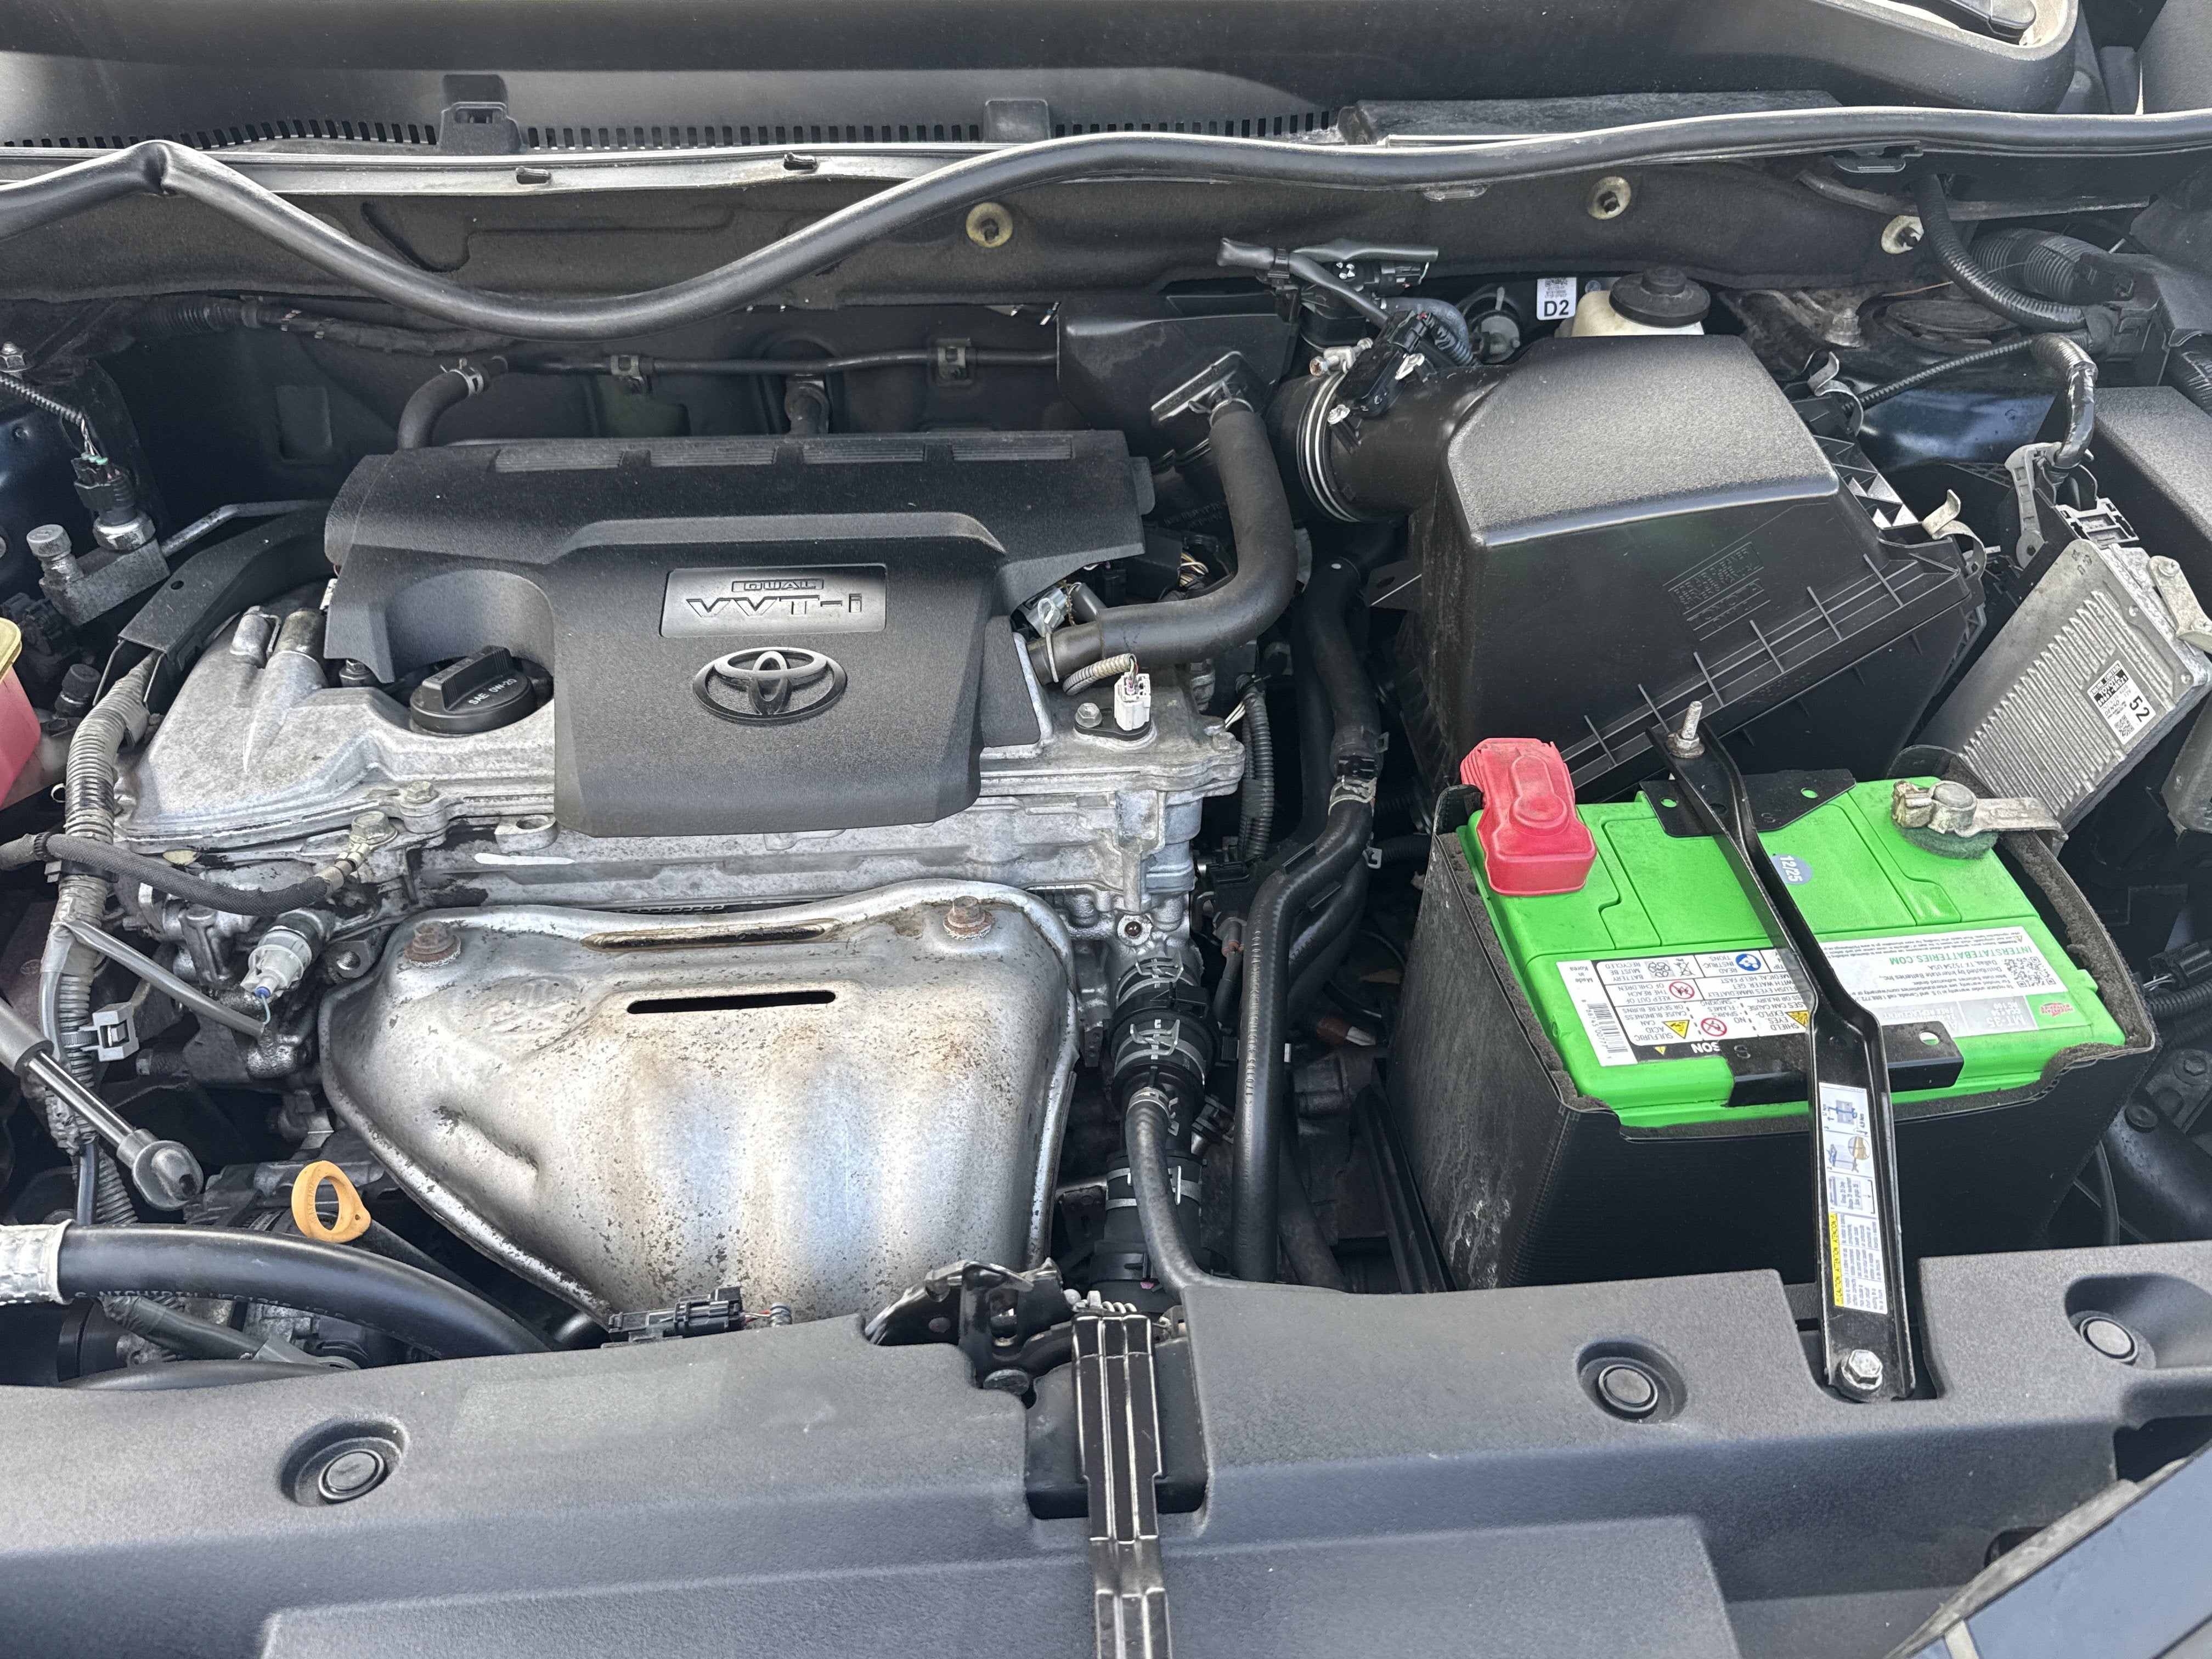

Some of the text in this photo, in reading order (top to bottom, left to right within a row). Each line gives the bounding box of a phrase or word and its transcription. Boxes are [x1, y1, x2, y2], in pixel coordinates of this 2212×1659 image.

[1544, 300, 1569, 317] D2
[686, 594, 862, 618] VVT-i
[469, 678, 517, 705] SAE 0W-20
[2098, 675, 2120, 696] TOYOTA
[2104, 700, 2119, 716] DENSO
[2129, 695, 2150, 722] 52
[1780, 855, 1802, 882] 12/25
[1886, 945, 2034, 965] INTERSTATEBATTERIES.COM
[1604, 961, 1641, 969] RECYCLED
[1965, 966, 2003, 974] Distributed
[1893, 973, 1926, 981] Batteries
[1923, 969, 1957, 978] Interstate
[1616, 983, 1654, 991] CHILDREN
[1706, 989, 1754, 997] IMMEDIATELY
[1623, 1012, 1663, 1020] BLINDNESS
[1881, 1006, 1955, 1019] FREE REPLACEMENT
[1769, 1022, 1800, 1031] SHIELD
[1983, 1014, 2028, 1028] MT-35
[1632, 1032, 1674, 1041] SULFURIC
[1689, 1041, 1722, 1053] SON
[1244, 1057, 1256, 1096] 170105
